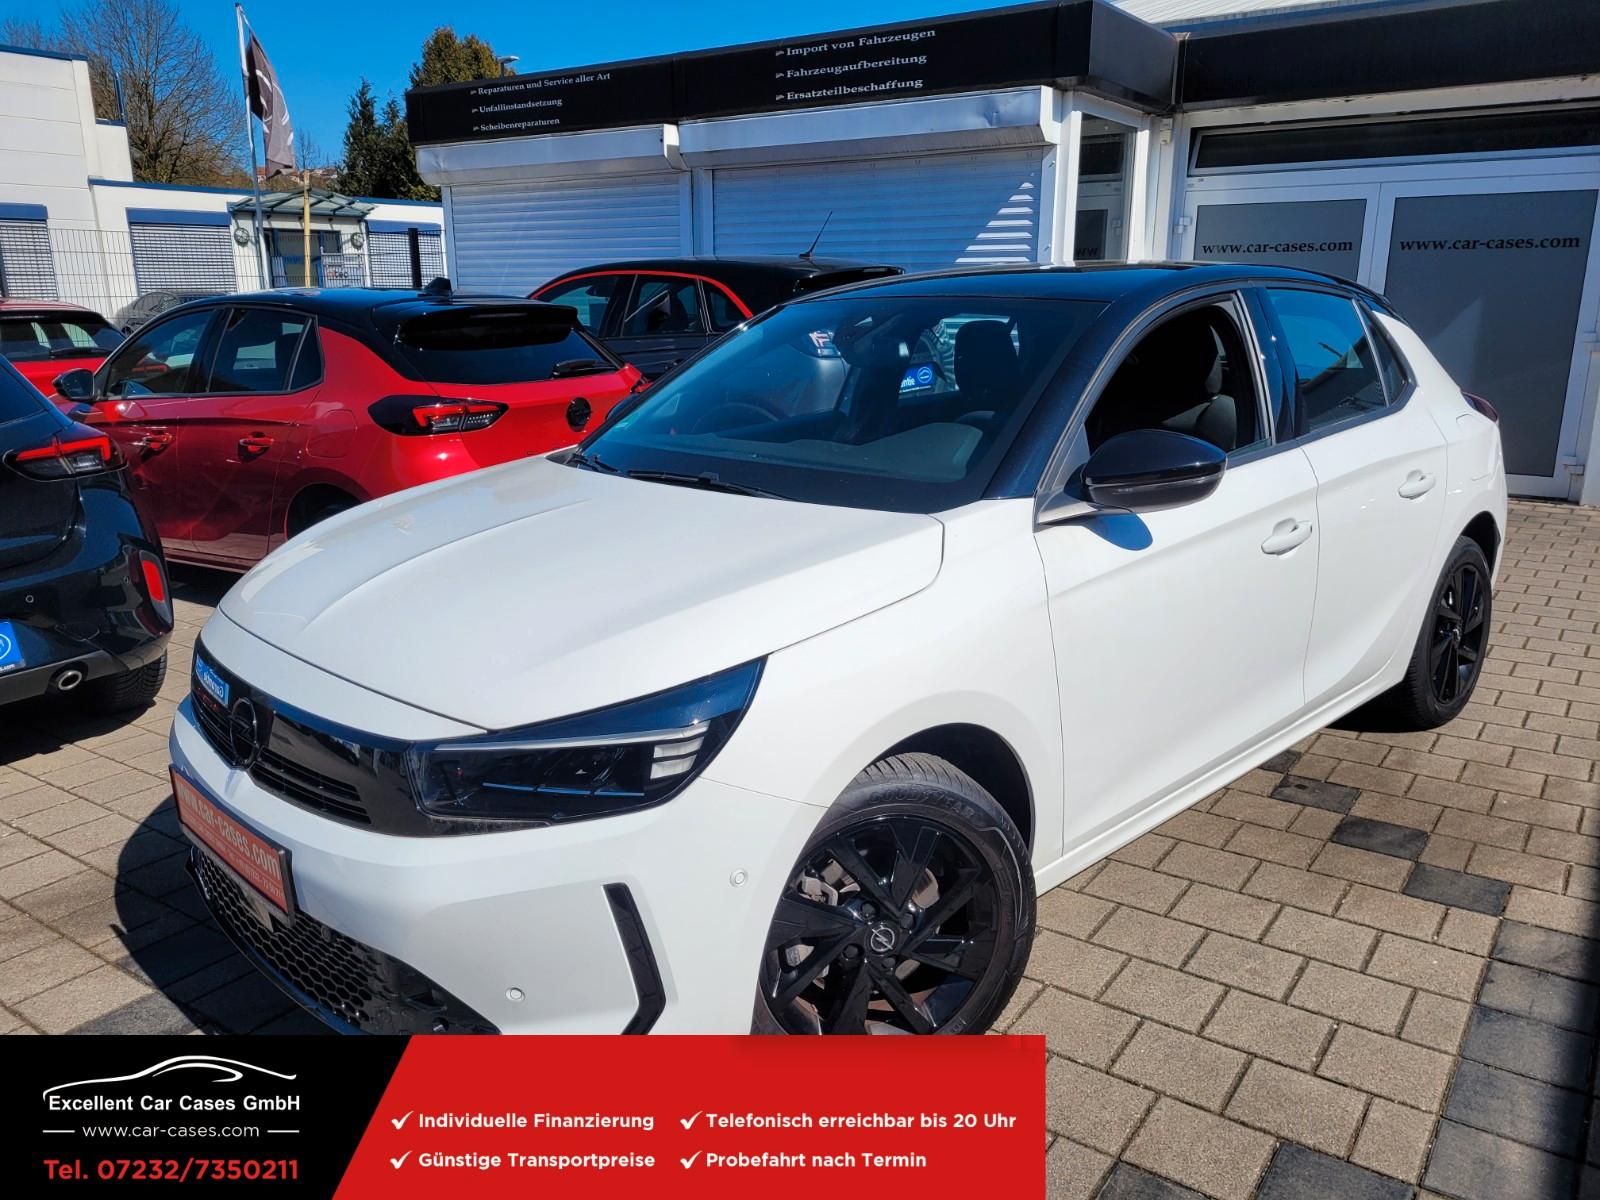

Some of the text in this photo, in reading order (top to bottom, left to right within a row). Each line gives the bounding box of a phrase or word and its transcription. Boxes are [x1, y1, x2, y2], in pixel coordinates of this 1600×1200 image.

[786, 30, 936, 56] Import von Fahrzeugen
[787, 55, 927, 77] Fahrzeugaufbereitung
[478, 72, 611, 95] Reparaturen und Service aller Art
[787, 79, 923, 99] Ersatzteilbeschaffung
[479, 98, 563, 113] Unfallinstandsetzung
[480, 118, 560, 131] Scheibenreparaturen
[1202, 240, 1353, 254] www.car-cases.com
[1400, 236, 1580, 250] www.car-cases.com
